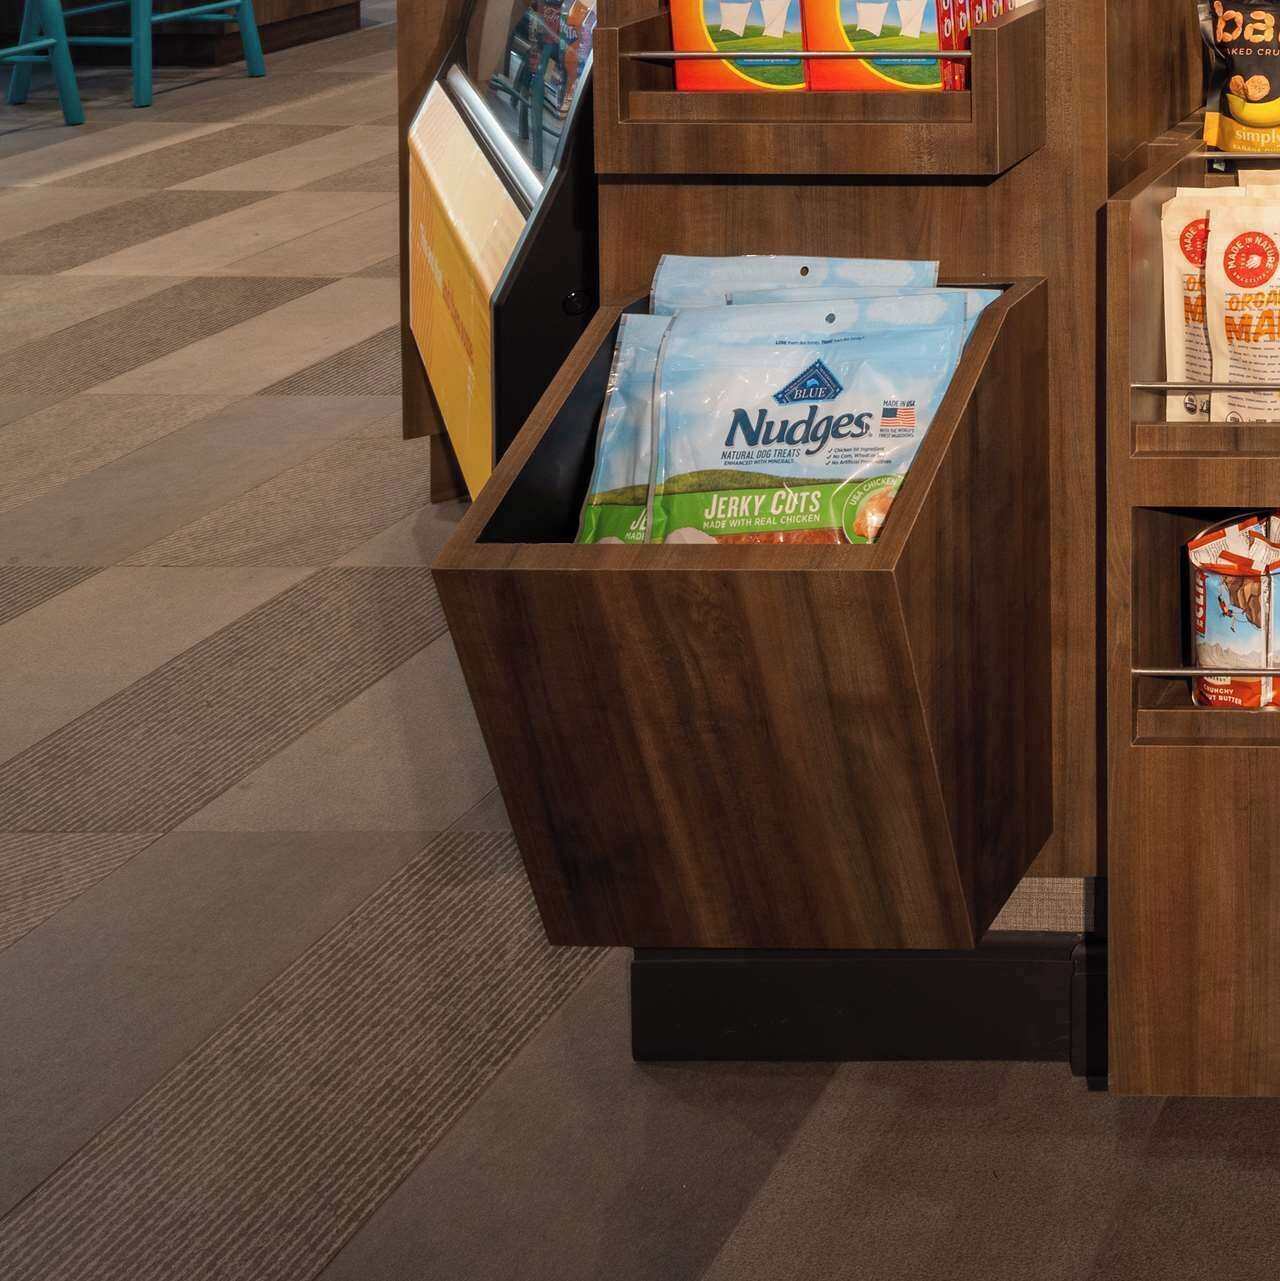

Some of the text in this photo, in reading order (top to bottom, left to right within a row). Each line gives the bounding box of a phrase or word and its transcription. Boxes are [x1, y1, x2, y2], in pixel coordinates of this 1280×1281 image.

[793, 387, 827, 400] BLUE
[724, 405, 873, 456] Nudges
[721, 448, 801, 460] NATURAL TREATS
[704, 490, 822, 520] JERKY CUTS
[703, 513, 820, 529] MADE WITH REAL CHICKEN
